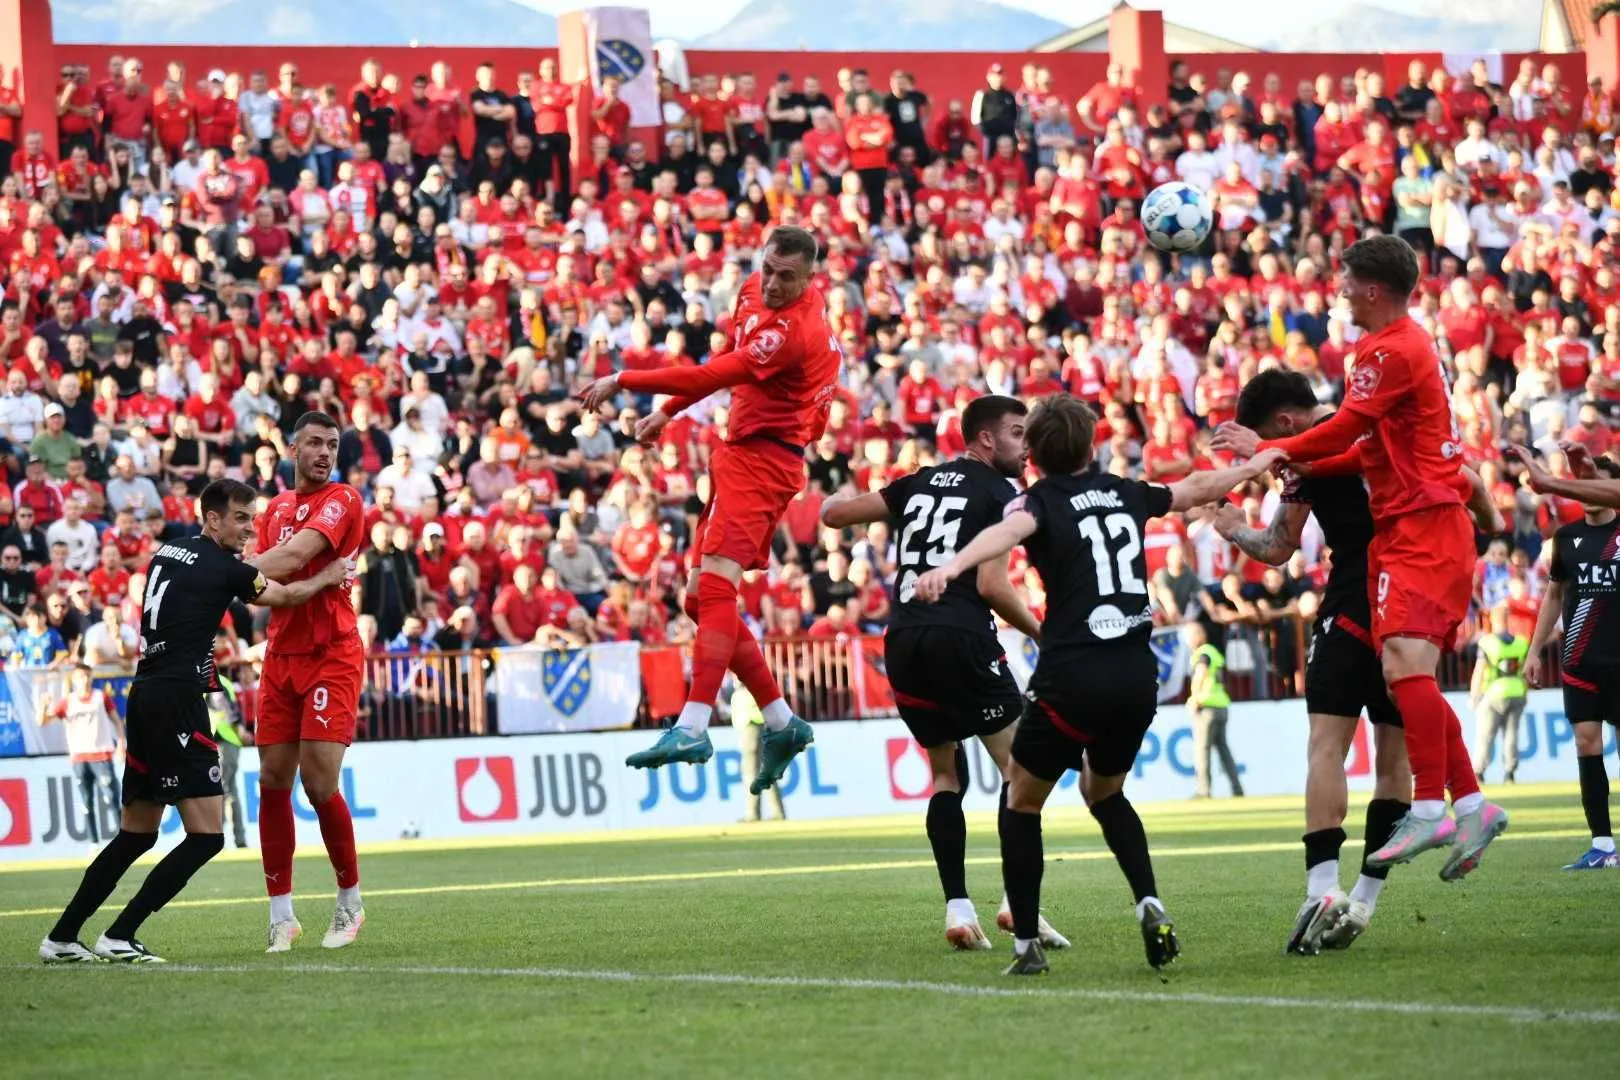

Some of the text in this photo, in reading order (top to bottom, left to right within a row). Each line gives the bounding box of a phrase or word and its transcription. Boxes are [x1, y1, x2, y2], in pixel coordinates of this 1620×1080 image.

[900, 493, 969, 568] 25
[1078, 512, 1148, 597] 12
[143, 565, 171, 631] 4
[1377, 571, 1390, 603] 9
[312, 687, 329, 711] 9
[529, 752, 608, 819] JUB
